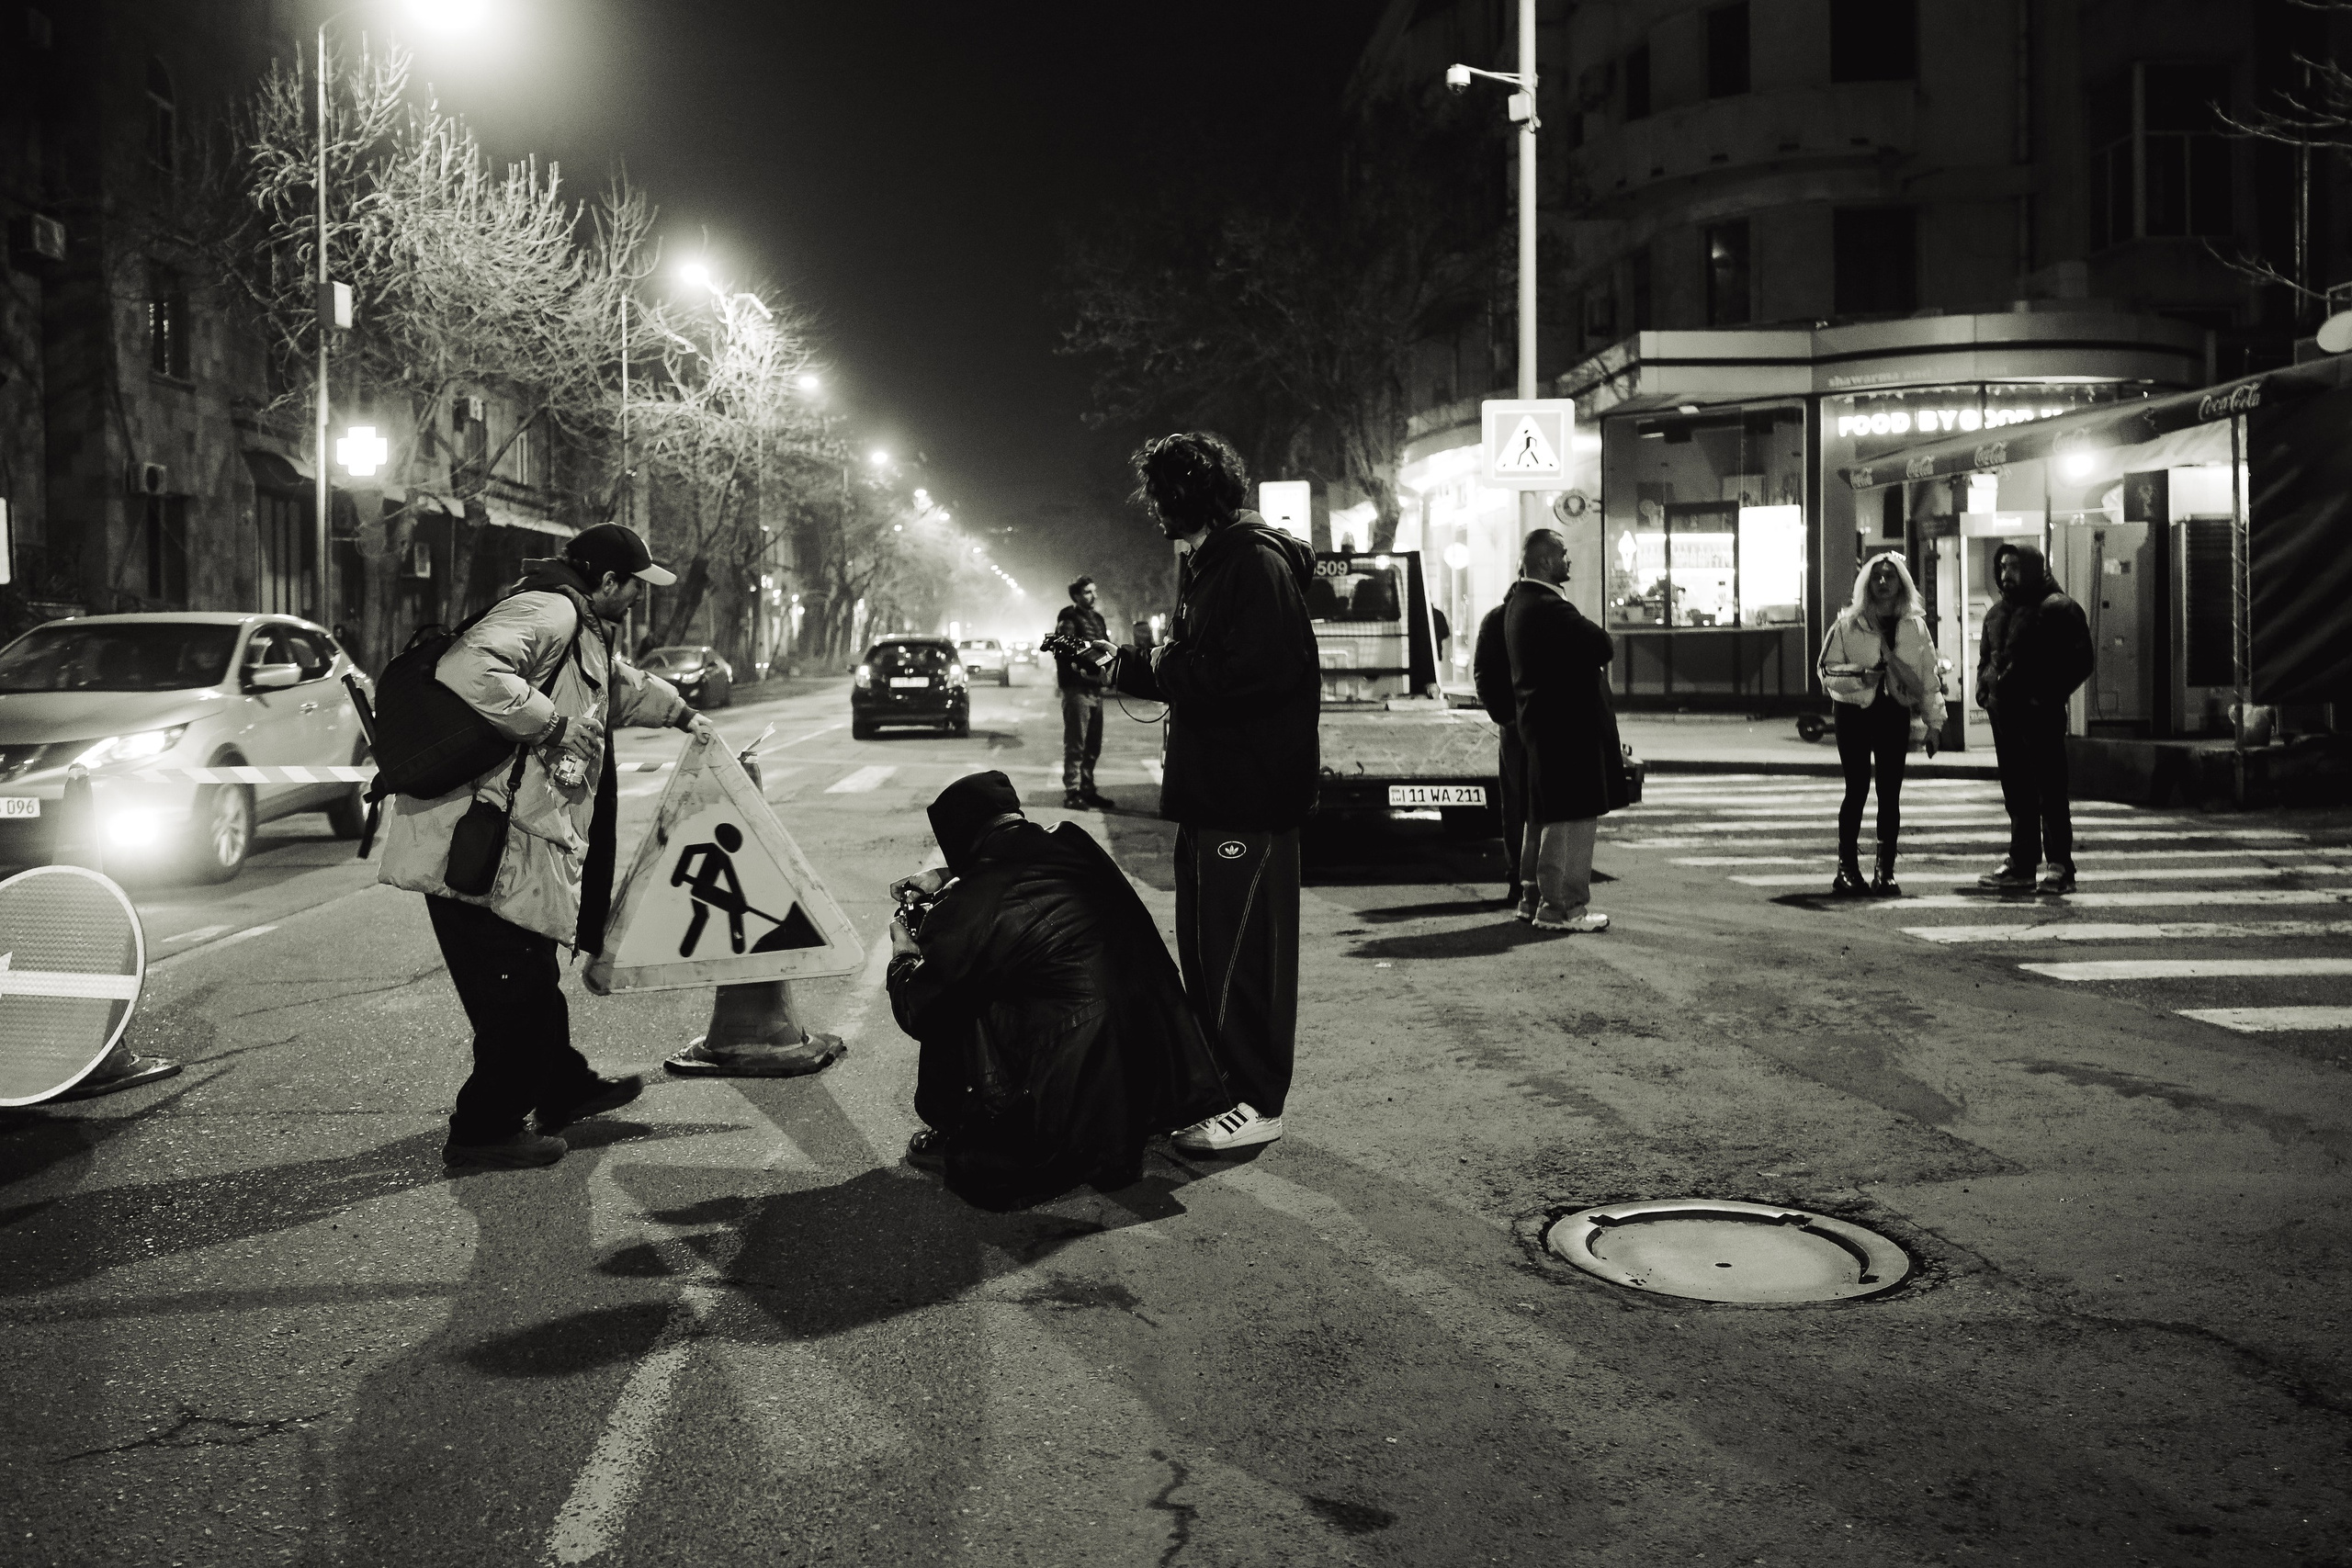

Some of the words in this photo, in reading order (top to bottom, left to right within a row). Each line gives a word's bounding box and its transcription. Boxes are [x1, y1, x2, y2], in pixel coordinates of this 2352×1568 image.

[2199, 381, 2262, 422] Coca-Cola
[1838, 412, 1911, 437] FOOD
[1918, 410, 1958, 432] BY
[1313, 559, 1349, 577] 509
[1408, 788, 1426, 803] 11
[1430, 788, 1452, 803] WA
[1455, 788, 1482, 803] 211
[6, 799, 35, 815] 096
